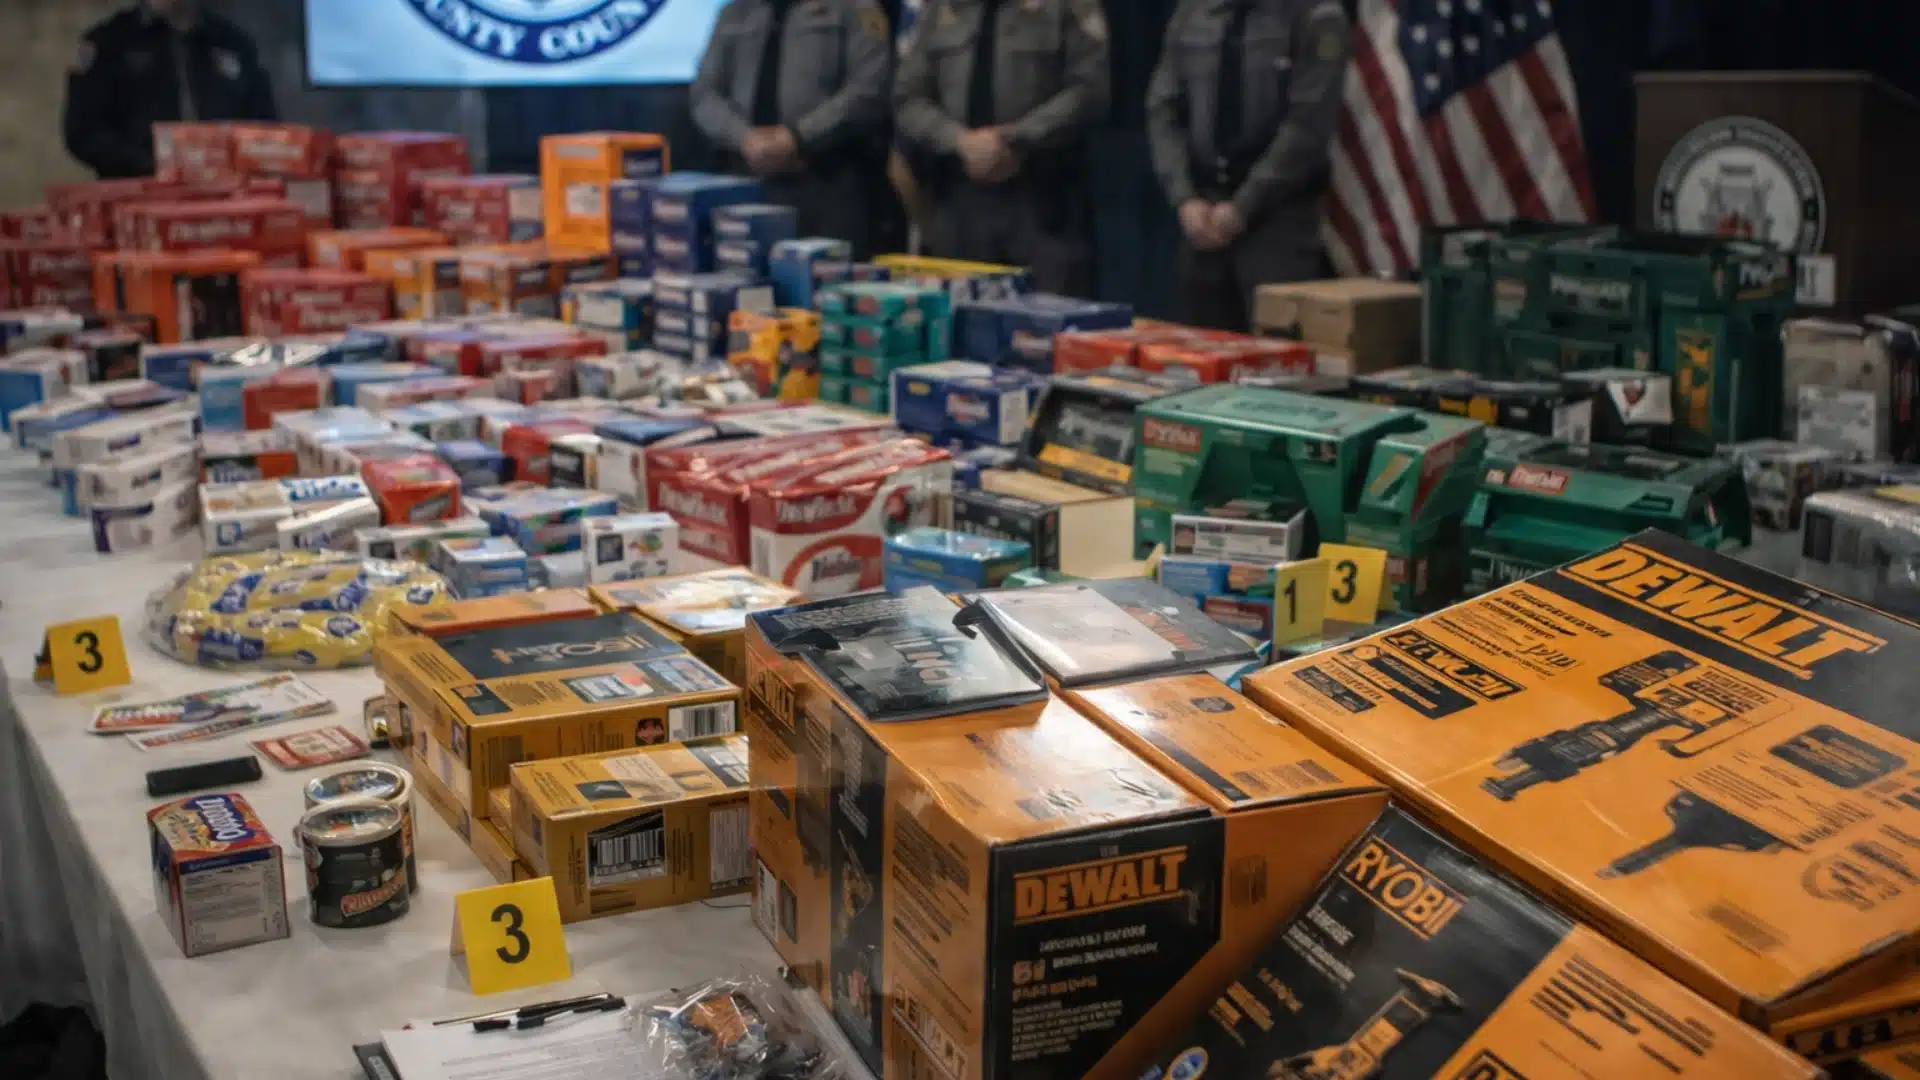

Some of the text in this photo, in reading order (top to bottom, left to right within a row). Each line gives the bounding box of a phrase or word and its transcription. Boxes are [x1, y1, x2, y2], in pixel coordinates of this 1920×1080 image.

[1283, 579, 1297, 625] 1
[1331, 559, 1358, 604] 3
[1567, 548, 1874, 667] DEWALT
[74, 630, 104, 674] 3
[1014, 852, 1188, 919] DEWALT
[491, 903, 531, 965] 3
